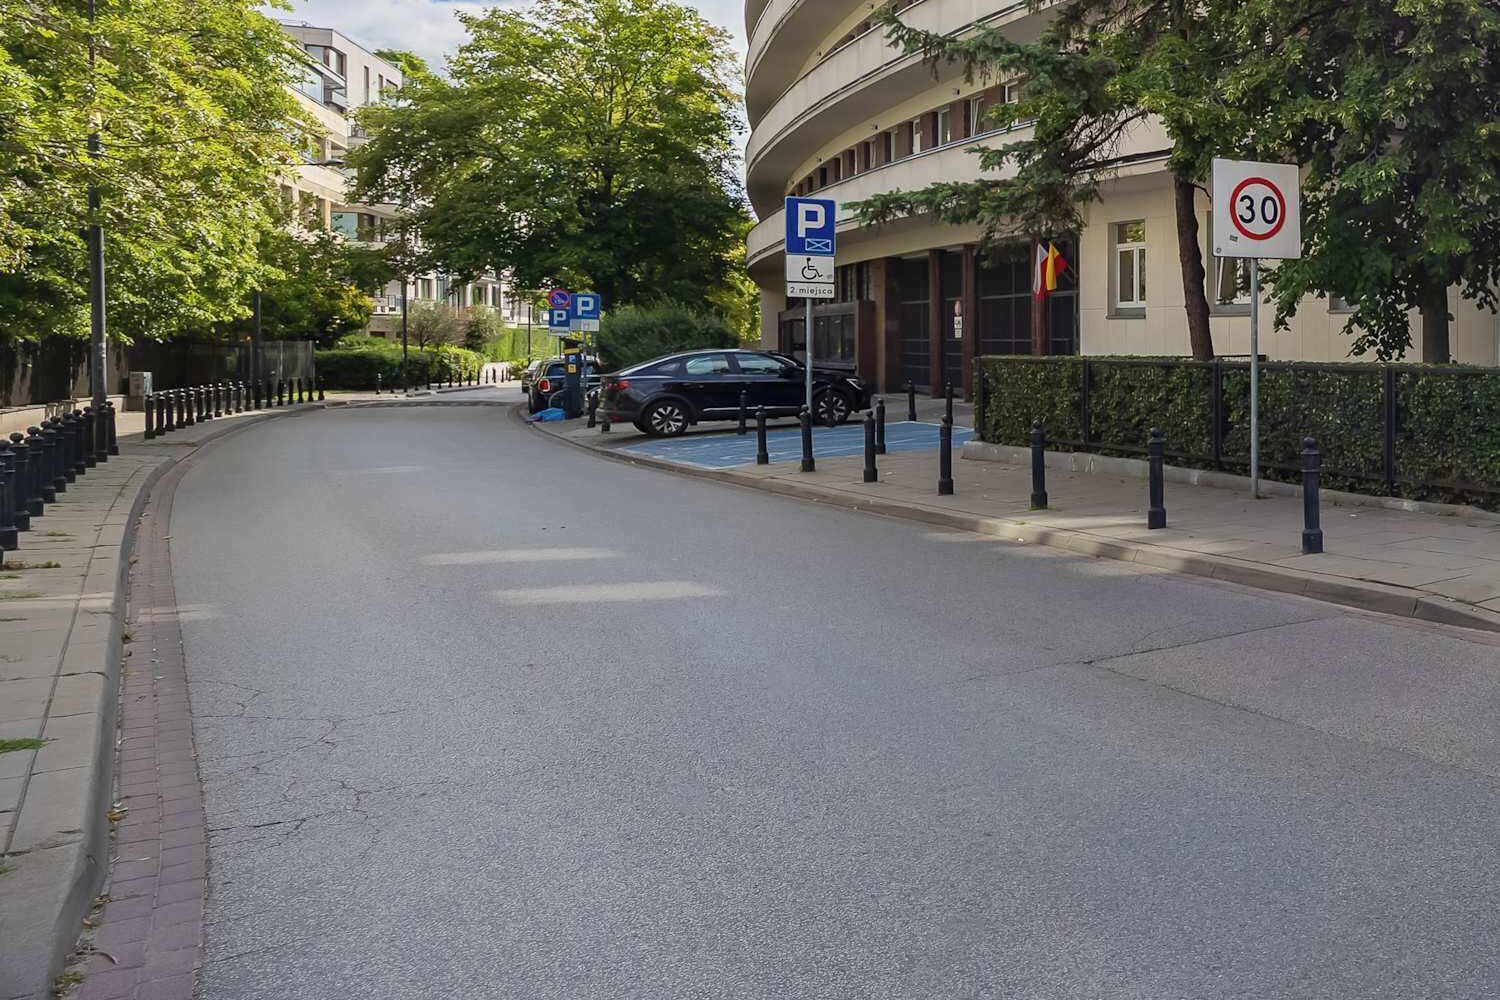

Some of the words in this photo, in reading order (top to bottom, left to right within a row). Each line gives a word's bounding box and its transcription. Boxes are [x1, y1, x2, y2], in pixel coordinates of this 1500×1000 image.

[797, 203, 825, 237] P
[1239, 195, 1278, 224] 30
[553, 310, 566, 325] P
[577, 297, 594, 316] P
